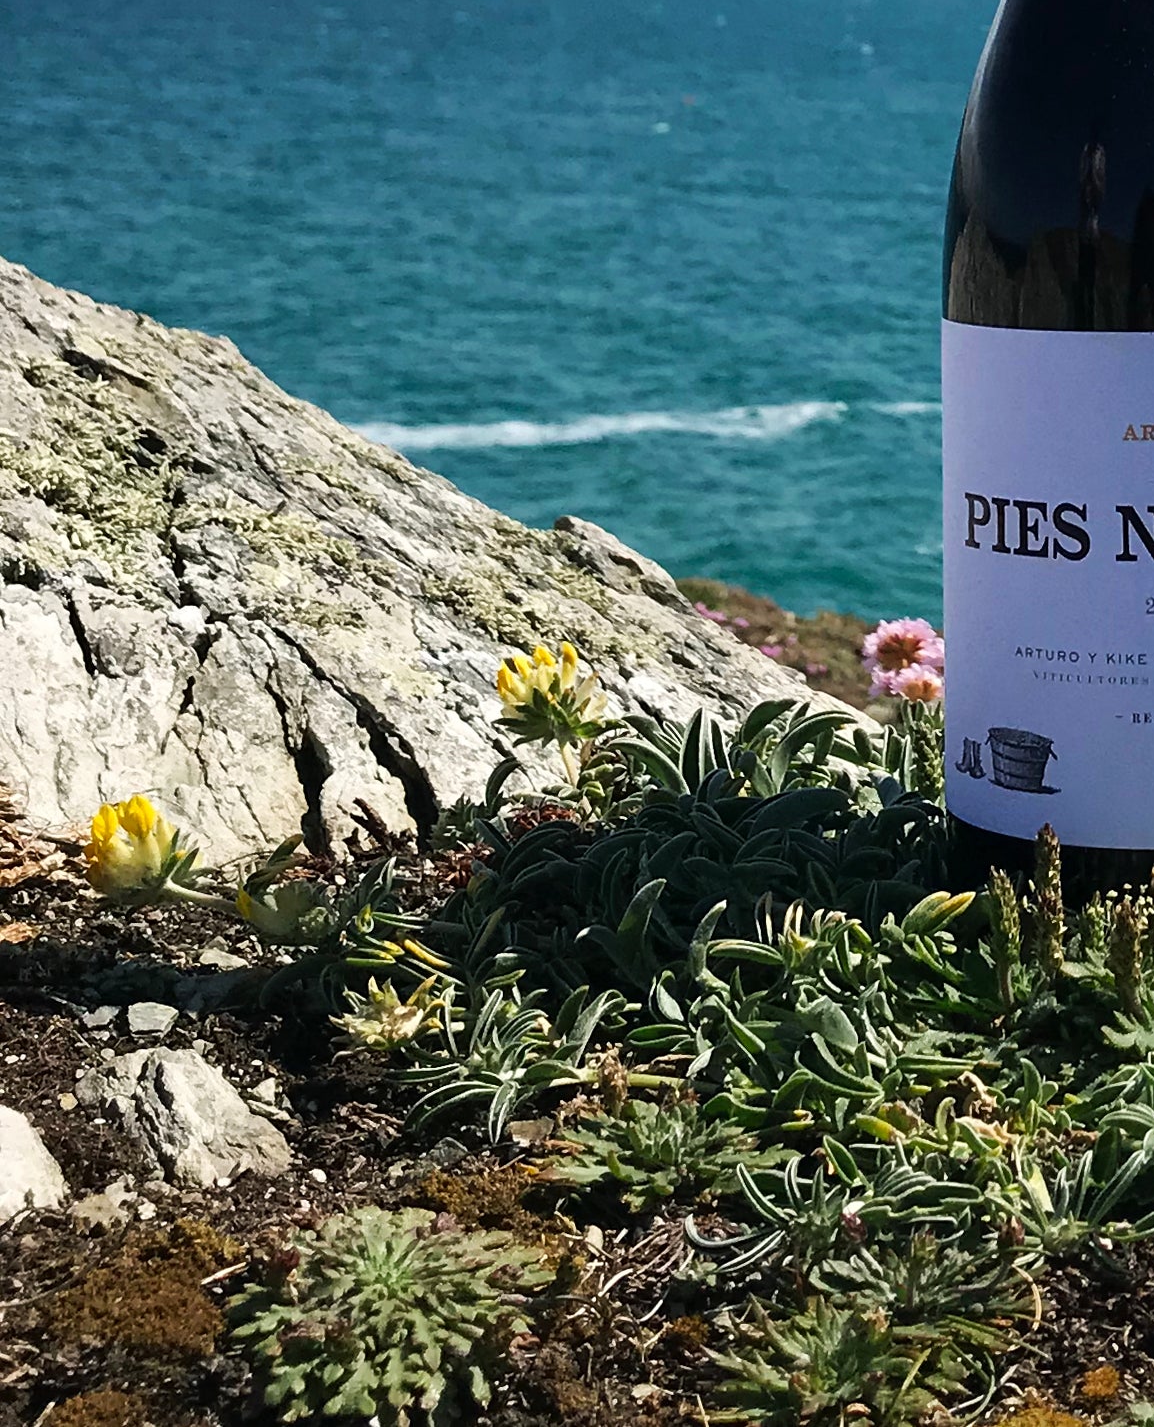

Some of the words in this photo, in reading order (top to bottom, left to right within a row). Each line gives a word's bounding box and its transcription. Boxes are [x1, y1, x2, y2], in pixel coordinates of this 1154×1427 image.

[964, 492, 1091, 561] PIES
[1014, 646, 1080, 663] ARTURO
[1088, 652, 1097, 664] Y
[1106, 653, 1147, 665] KIKE
[1033, 670, 1149, 685] VITICULTORES
